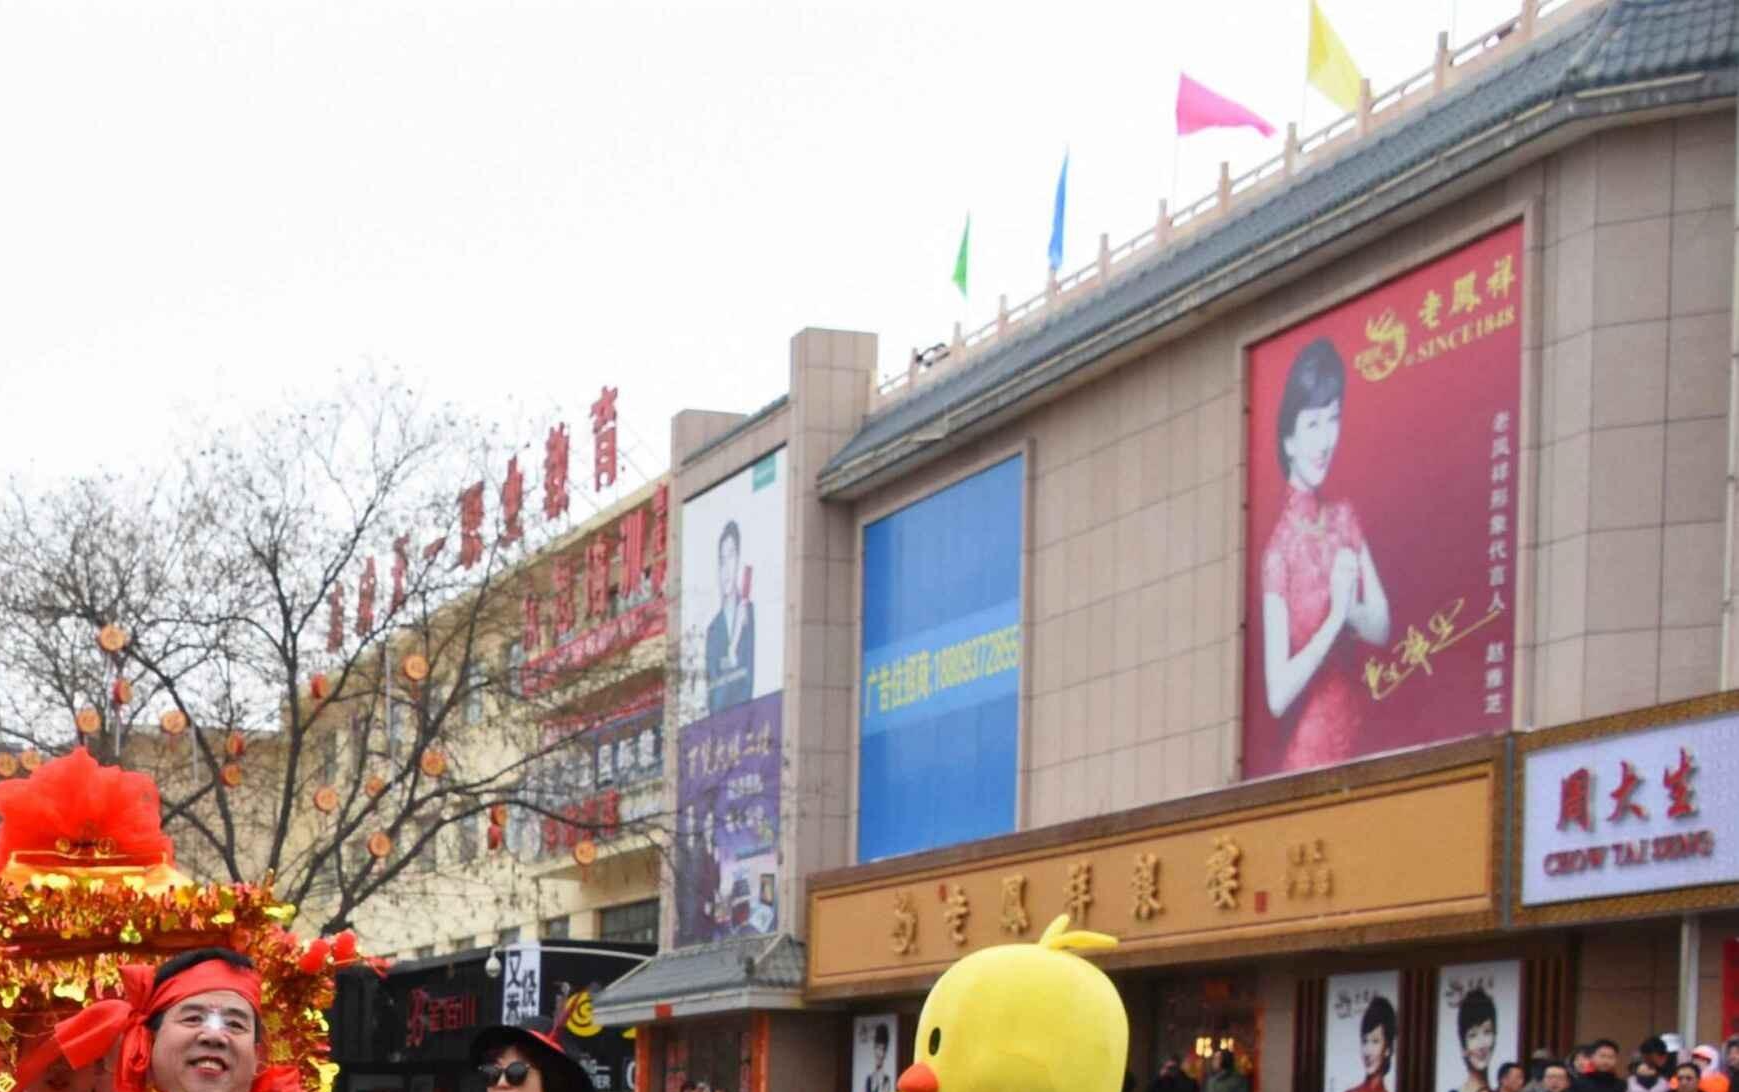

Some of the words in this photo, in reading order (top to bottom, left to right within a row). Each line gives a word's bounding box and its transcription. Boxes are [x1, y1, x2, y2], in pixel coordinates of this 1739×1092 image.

[1556, 747, 1699, 833] 周大生
[1543, 846, 1609, 878] CHOW
[1611, 838, 1652, 867] TAI
